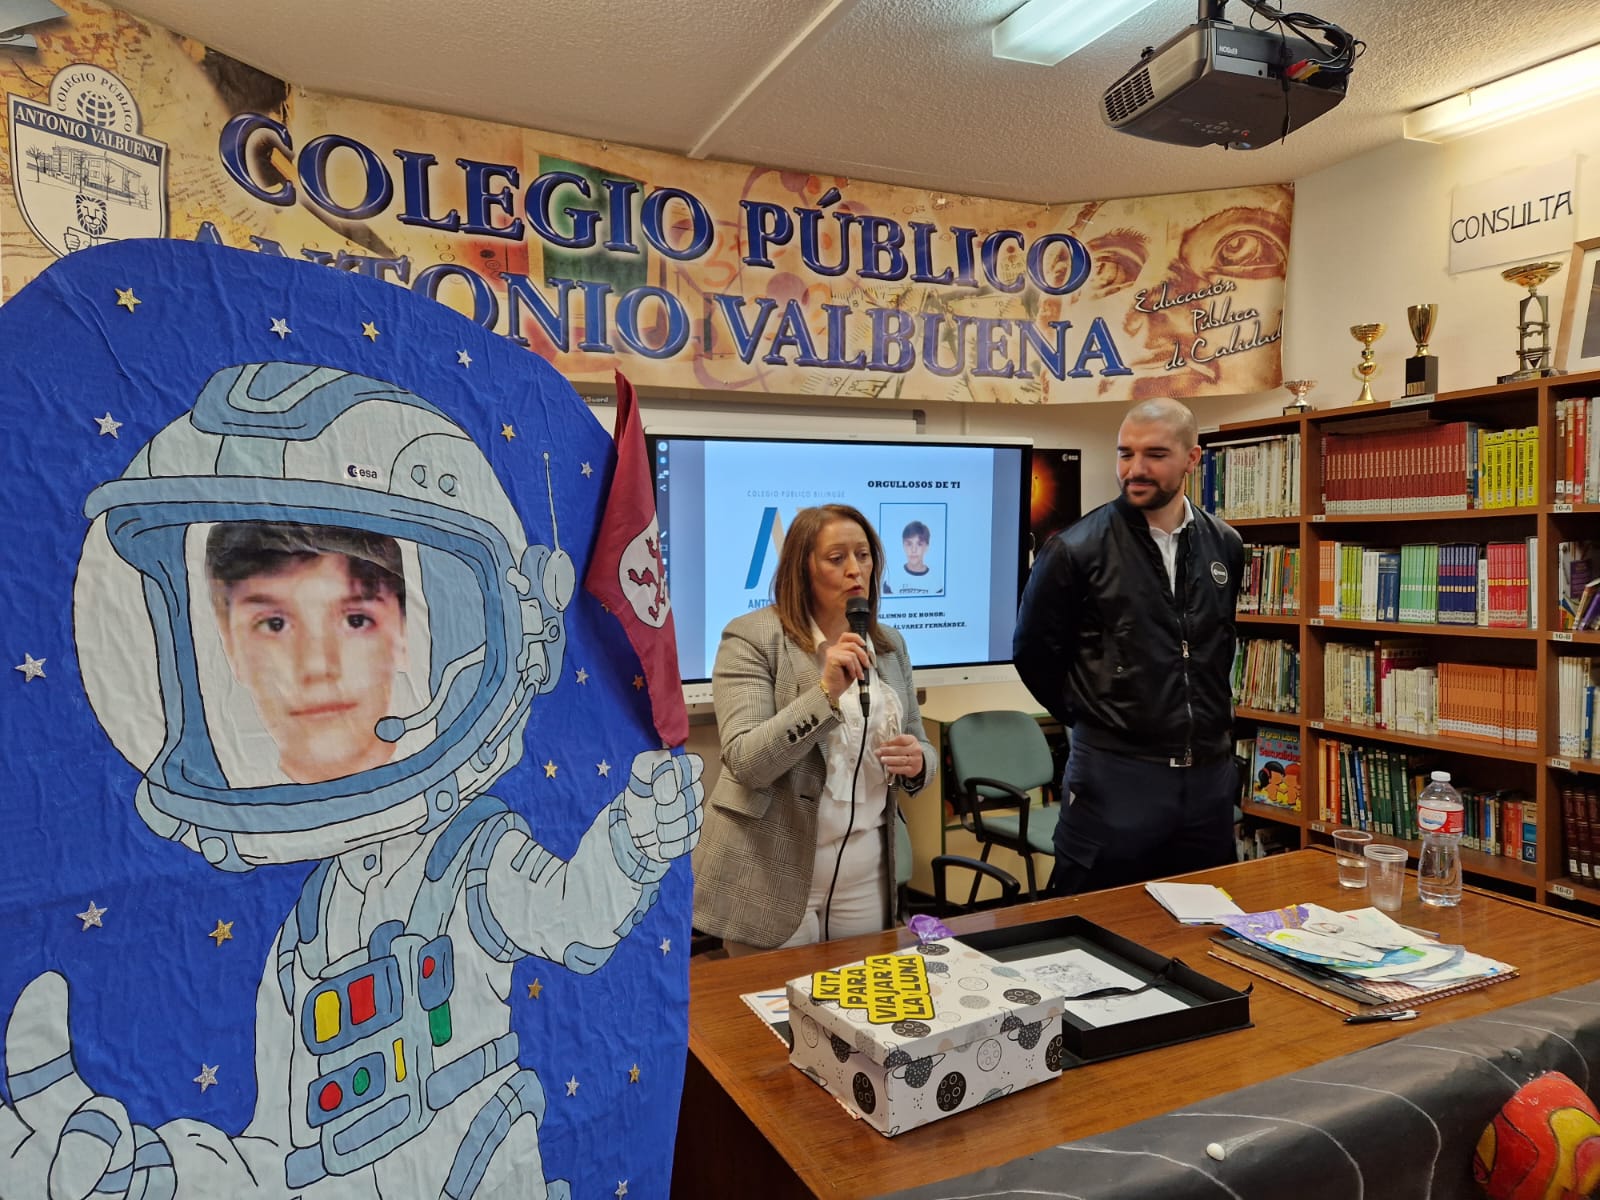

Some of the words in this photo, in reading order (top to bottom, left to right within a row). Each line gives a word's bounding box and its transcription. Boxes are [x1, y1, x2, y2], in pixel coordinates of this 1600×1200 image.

[58, 72, 96, 112] COLEGIO
[100, 77, 133, 133] PÚBLICO
[15, 105, 87, 138] ANTONIO
[91, 128, 158, 162] VALBUENA
[219, 112, 715, 261] COLEGIO
[739, 187, 1092, 295] PÚBLICO
[1451, 190, 1573, 243] CONSULTA
[1134, 279, 1237, 313] Educación
[1191, 296, 1259, 334] Pública
[713, 294, 1134, 381] VALBUENA
[1165, 340, 1187, 371] de
[1191, 311, 1283, 363] Calidad
[359, 469, 378, 479] esa
[867, 480, 933, 489] ORGULLOSOS
[935, 481, 949, 489] DE
[951, 481, 961, 489] TI
[820, 975, 841, 995] KIT
[847, 968, 868, 1005] PARA
[873, 970, 900, 1019] VIAJAR
[897, 957, 921, 991] LUNA
